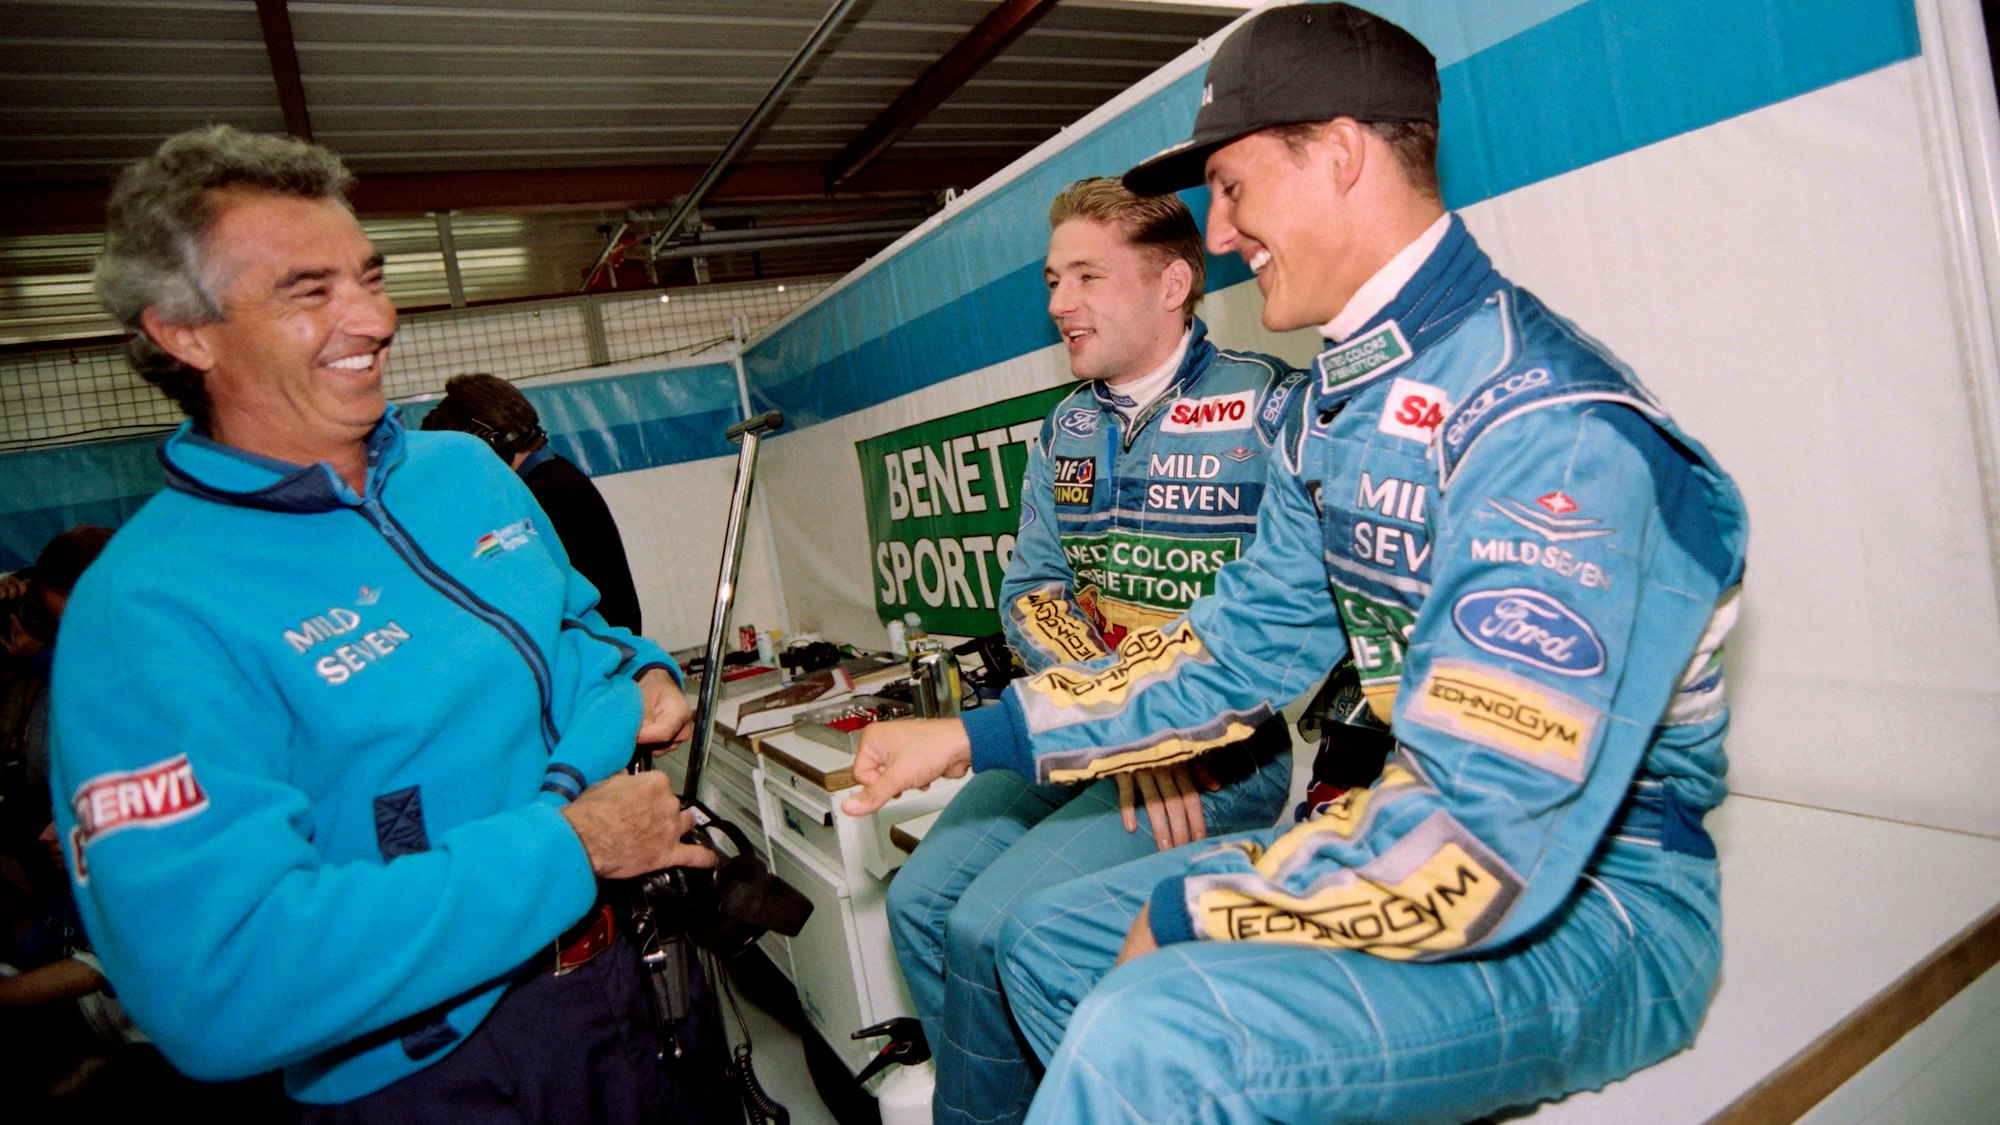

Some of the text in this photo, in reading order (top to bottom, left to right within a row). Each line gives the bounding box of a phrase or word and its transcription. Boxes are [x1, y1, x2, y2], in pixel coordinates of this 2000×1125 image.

[1345, 336, 1387, 362] COLORS
[1171, 399, 1246, 426] SANYO
[1263, 372, 1303, 422] sparco
[1447, 368, 1548, 446] sparco
[884, 419, 1045, 521] BENETT
[1150, 453, 1221, 479] MILD
[1148, 484, 1240, 511] SEVEN
[1357, 471, 1425, 524] MIL
[1112, 543, 1225, 574] COLORS
[1354, 522, 1430, 573] SEV
[1471, 539, 1613, 592] MILD SEVEN
[284, 607, 361, 655] MILD
[316, 620, 412, 685] SEVEN
[1479, 597, 1579, 662] Ford
[78, 763, 197, 829] ERVIT
